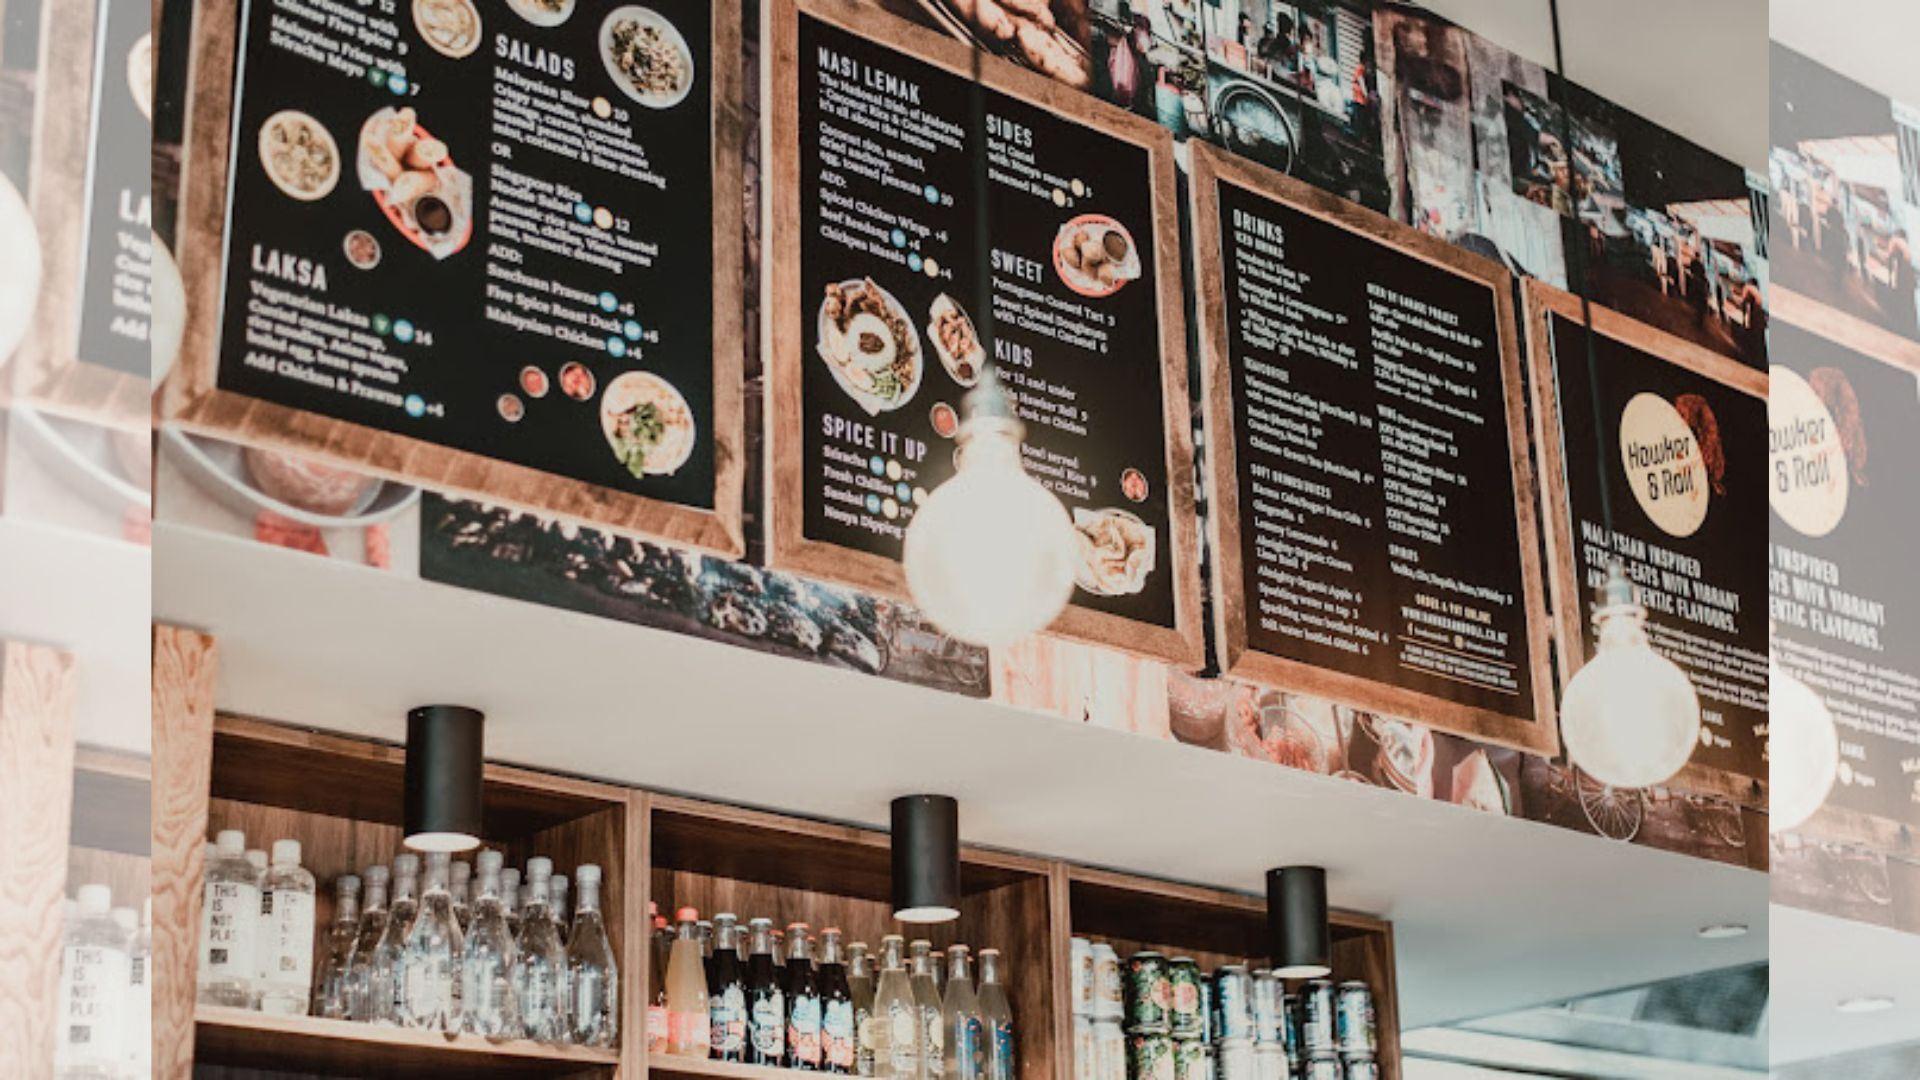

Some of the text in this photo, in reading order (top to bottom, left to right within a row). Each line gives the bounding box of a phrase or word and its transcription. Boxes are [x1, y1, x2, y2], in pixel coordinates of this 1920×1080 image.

[496, 33, 576, 81] SALADS
[818, 46, 920, 106] NASI LEMAK
[986, 113, 1033, 148] SIDES
[1233, 208, 1284, 244] DRINKS
[252, 244, 327, 291] LAKSA
[990, 248, 1043, 284] SWEET
[994, 337, 1032, 369] KIDS
[822, 412, 928, 462] SPICE IT UP
[1628, 436, 1690, 470] Hawker
[1647, 465, 1695, 501] & Roll
[1792, 450, 1830, 489] Roll
[1646, 544, 1702, 580] INSPIRED
[1776, 545, 1840, 586] INSPIRED
[1662, 572, 1691, 600] WITH
[1692, 578, 1740, 613] VIBRANT
[1792, 576, 1885, 628] WITH VIBRANT
[1676, 598, 1740, 634] FLAVOURS.
